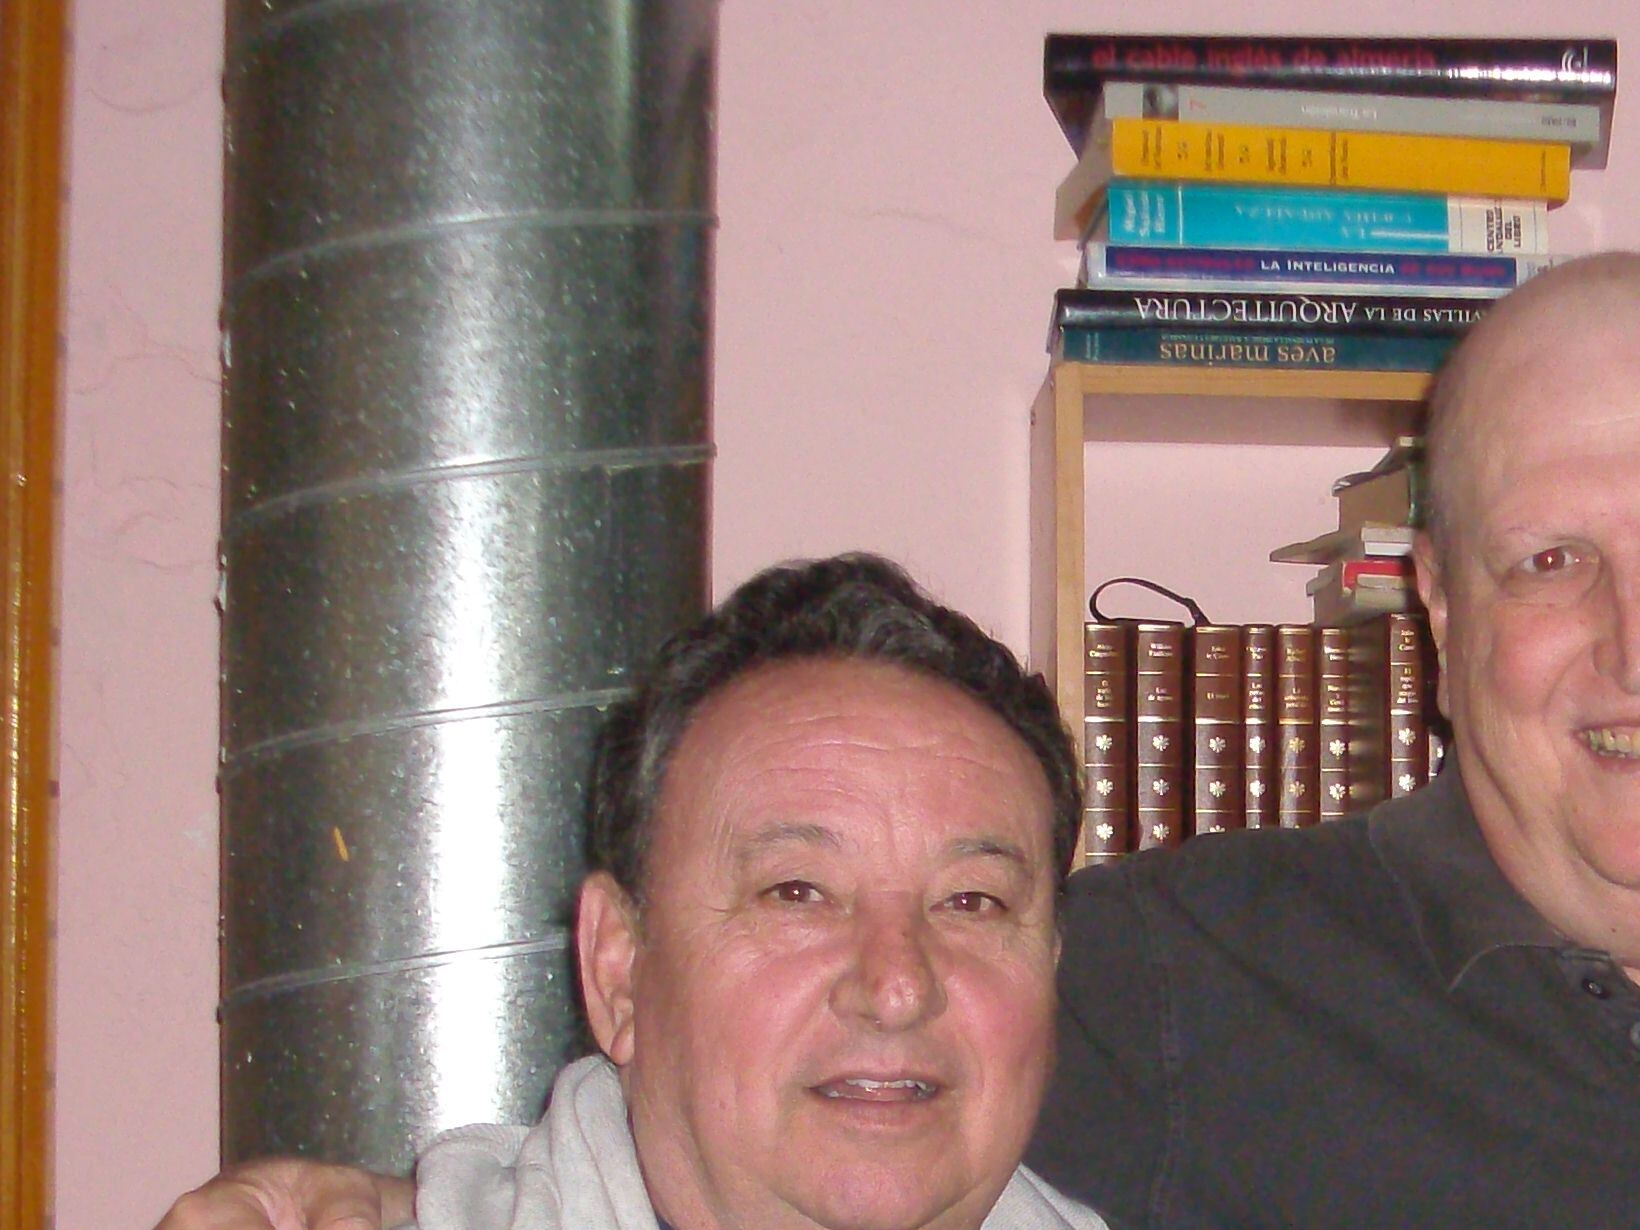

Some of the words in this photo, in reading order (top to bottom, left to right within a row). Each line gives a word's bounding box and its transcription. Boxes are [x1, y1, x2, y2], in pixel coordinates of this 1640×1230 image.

[1260, 259, 1281, 272] LA
[1133, 296, 1357, 324] ARQUITECTURA
[1363, 305, 1388, 321] LA
[1393, 306, 1415, 322] DE
[1423, 307, 1486, 324] VILLAS
[1159, 341, 1269, 367] marinas
[1277, 345, 1337, 364] aves
